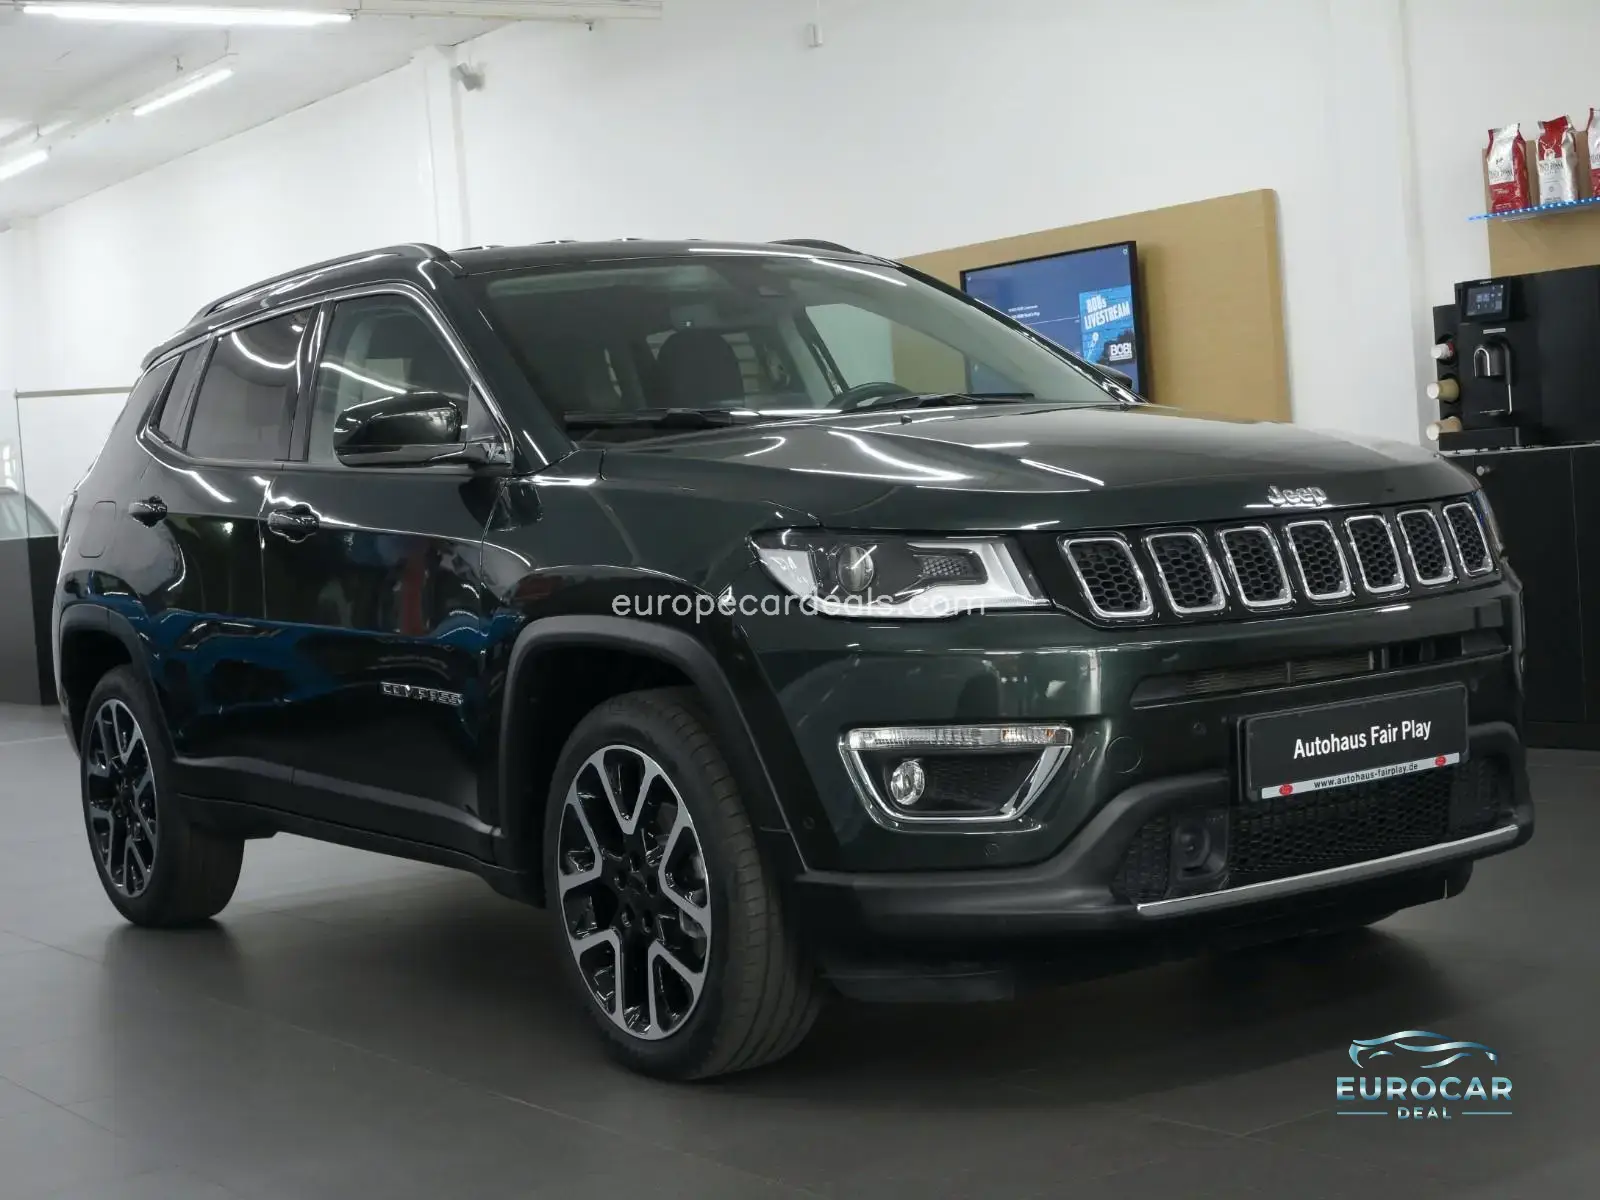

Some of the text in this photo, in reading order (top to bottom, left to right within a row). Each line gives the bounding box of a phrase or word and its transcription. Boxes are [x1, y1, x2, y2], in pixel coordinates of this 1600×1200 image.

[1083, 301, 1131, 331] LIVESTREAM
[1267, 484, 1328, 507] Jeep
[1293, 719, 1432, 760] Autohaus Fair Play
[1313, 761, 1419, 790] www.autohaus-fairplay.de
